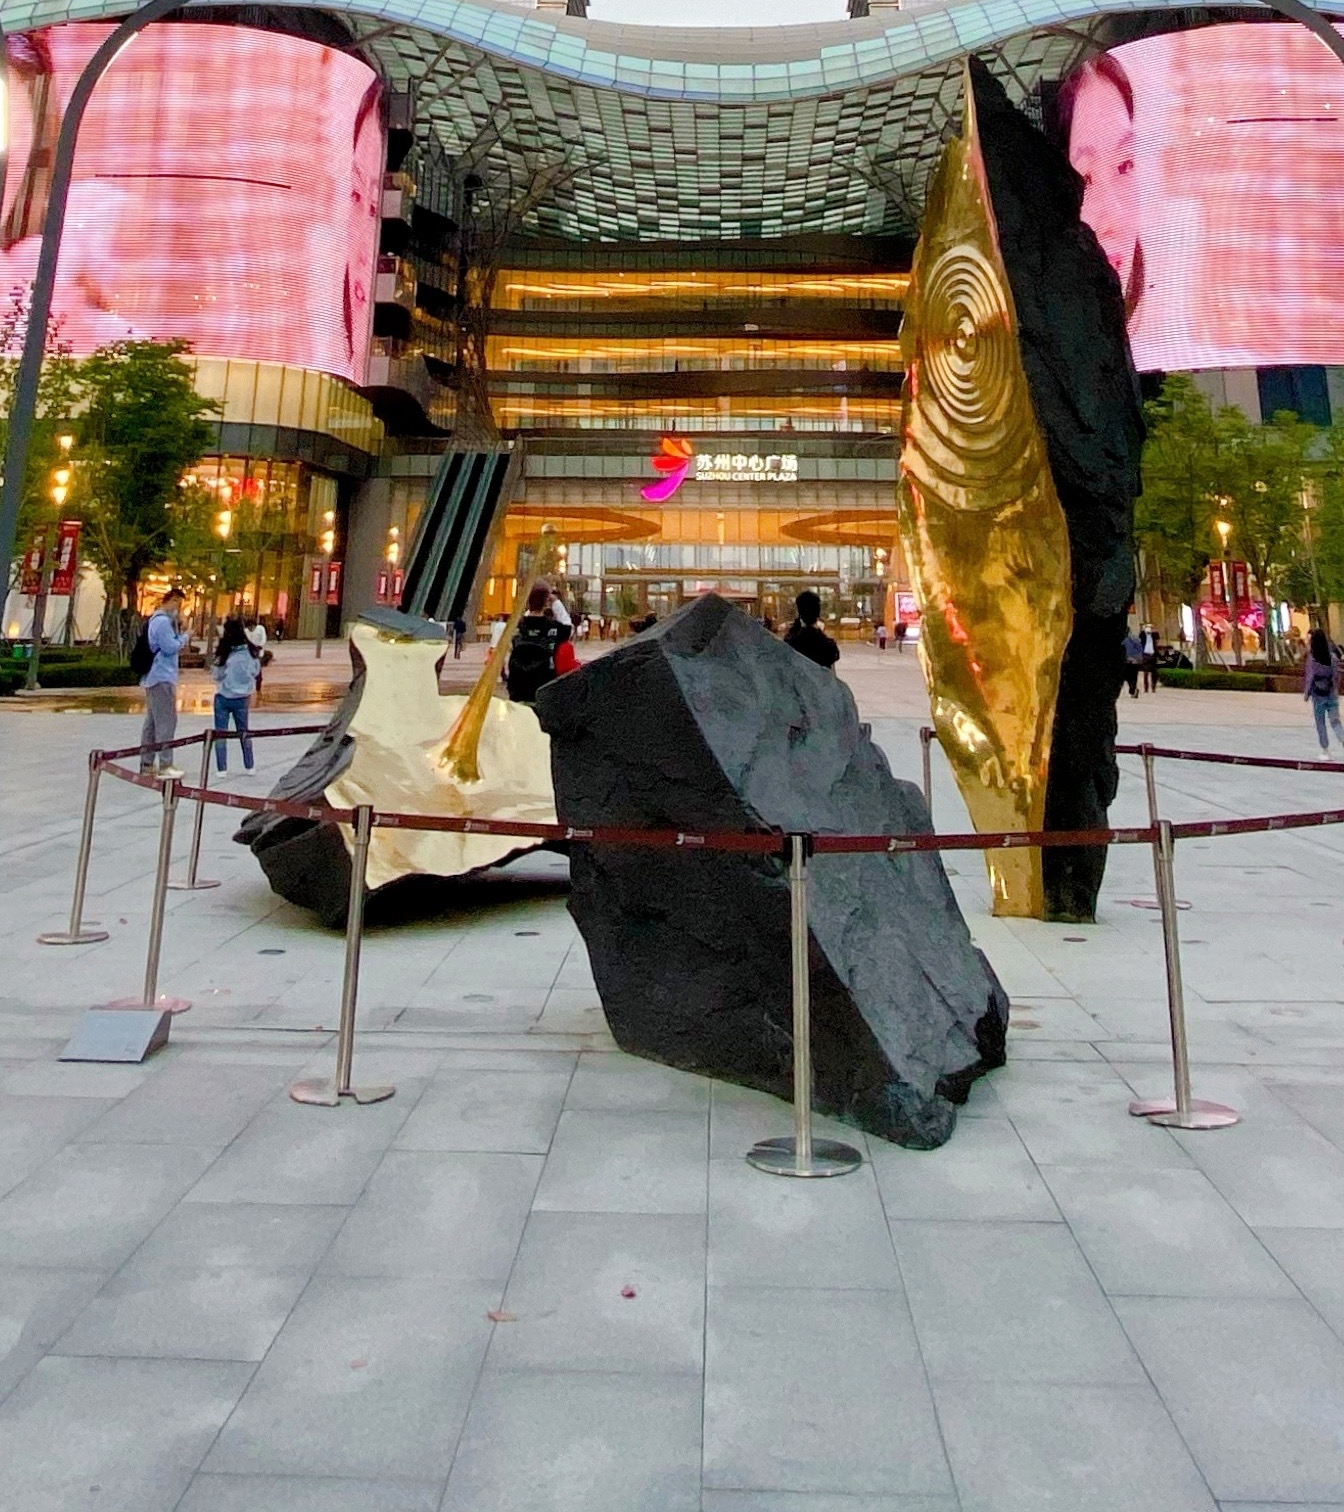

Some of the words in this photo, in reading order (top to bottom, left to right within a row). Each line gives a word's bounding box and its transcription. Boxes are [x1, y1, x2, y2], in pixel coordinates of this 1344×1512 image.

[696, 454, 798, 471] 苏州中心广场
[696, 471, 731, 481] SUZHOU
[732, 472, 766, 481] CENTER
[767, 472, 798, 481] PLAZA
